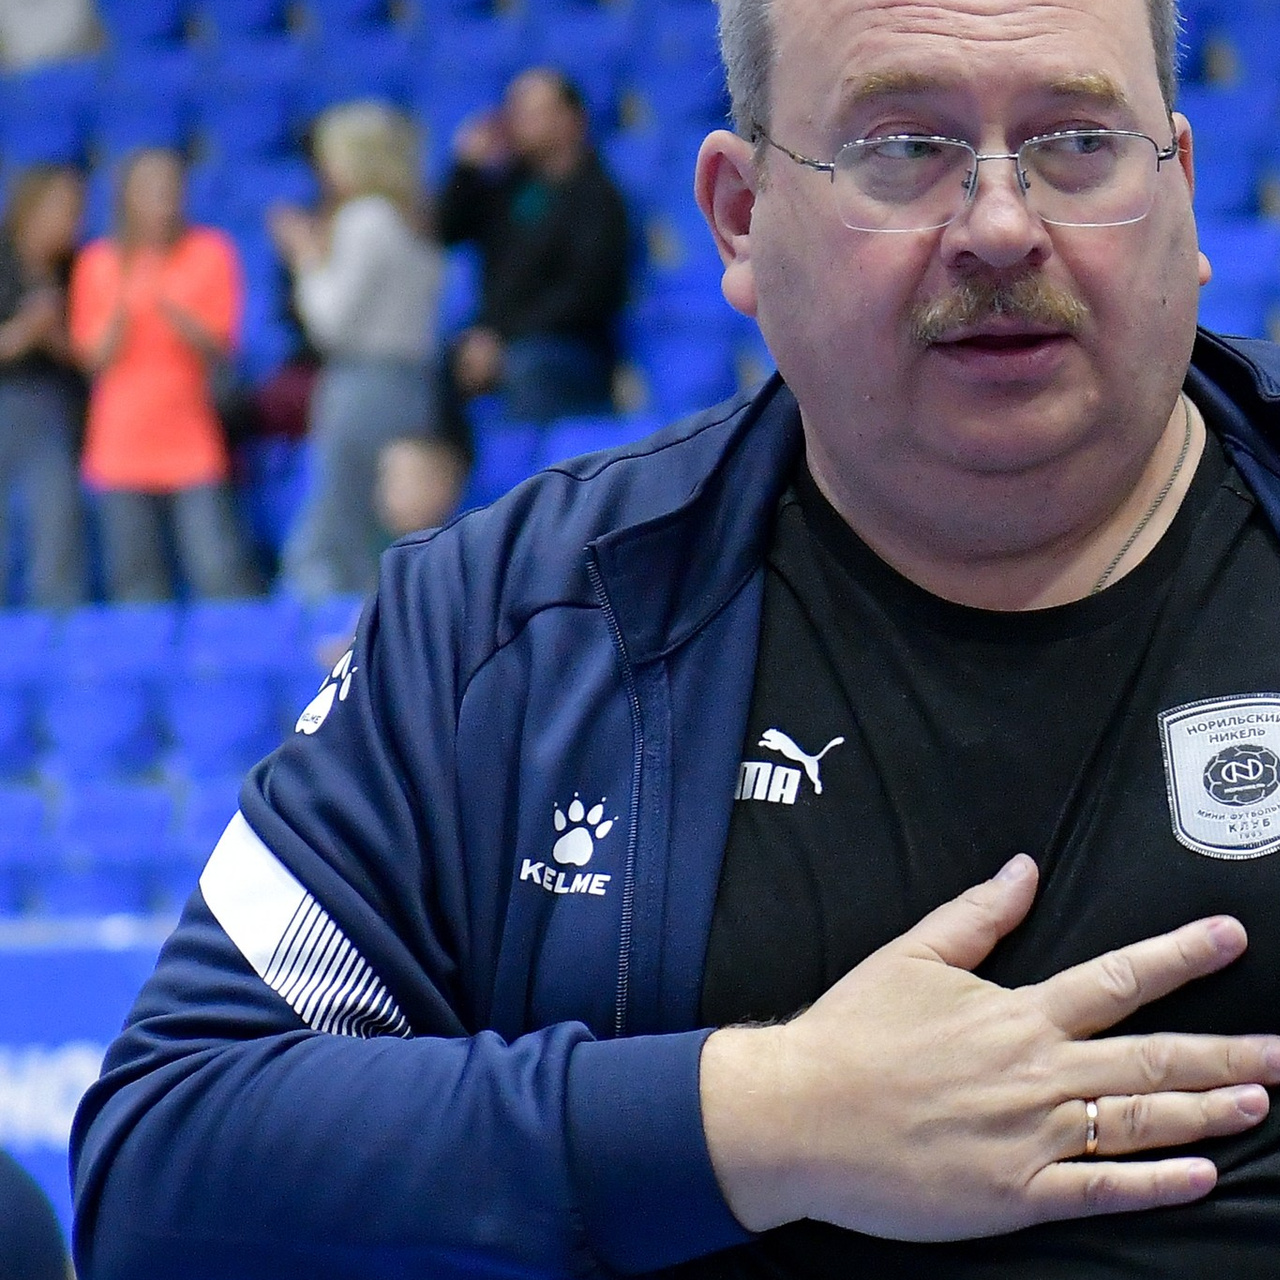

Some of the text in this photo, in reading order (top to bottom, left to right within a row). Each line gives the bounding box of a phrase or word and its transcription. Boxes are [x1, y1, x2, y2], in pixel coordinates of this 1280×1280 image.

[1209, 728, 1266, 743] НИКЕЛЬ
[734, 761, 802, 805] MA
[519, 858, 612, 896] KELME
